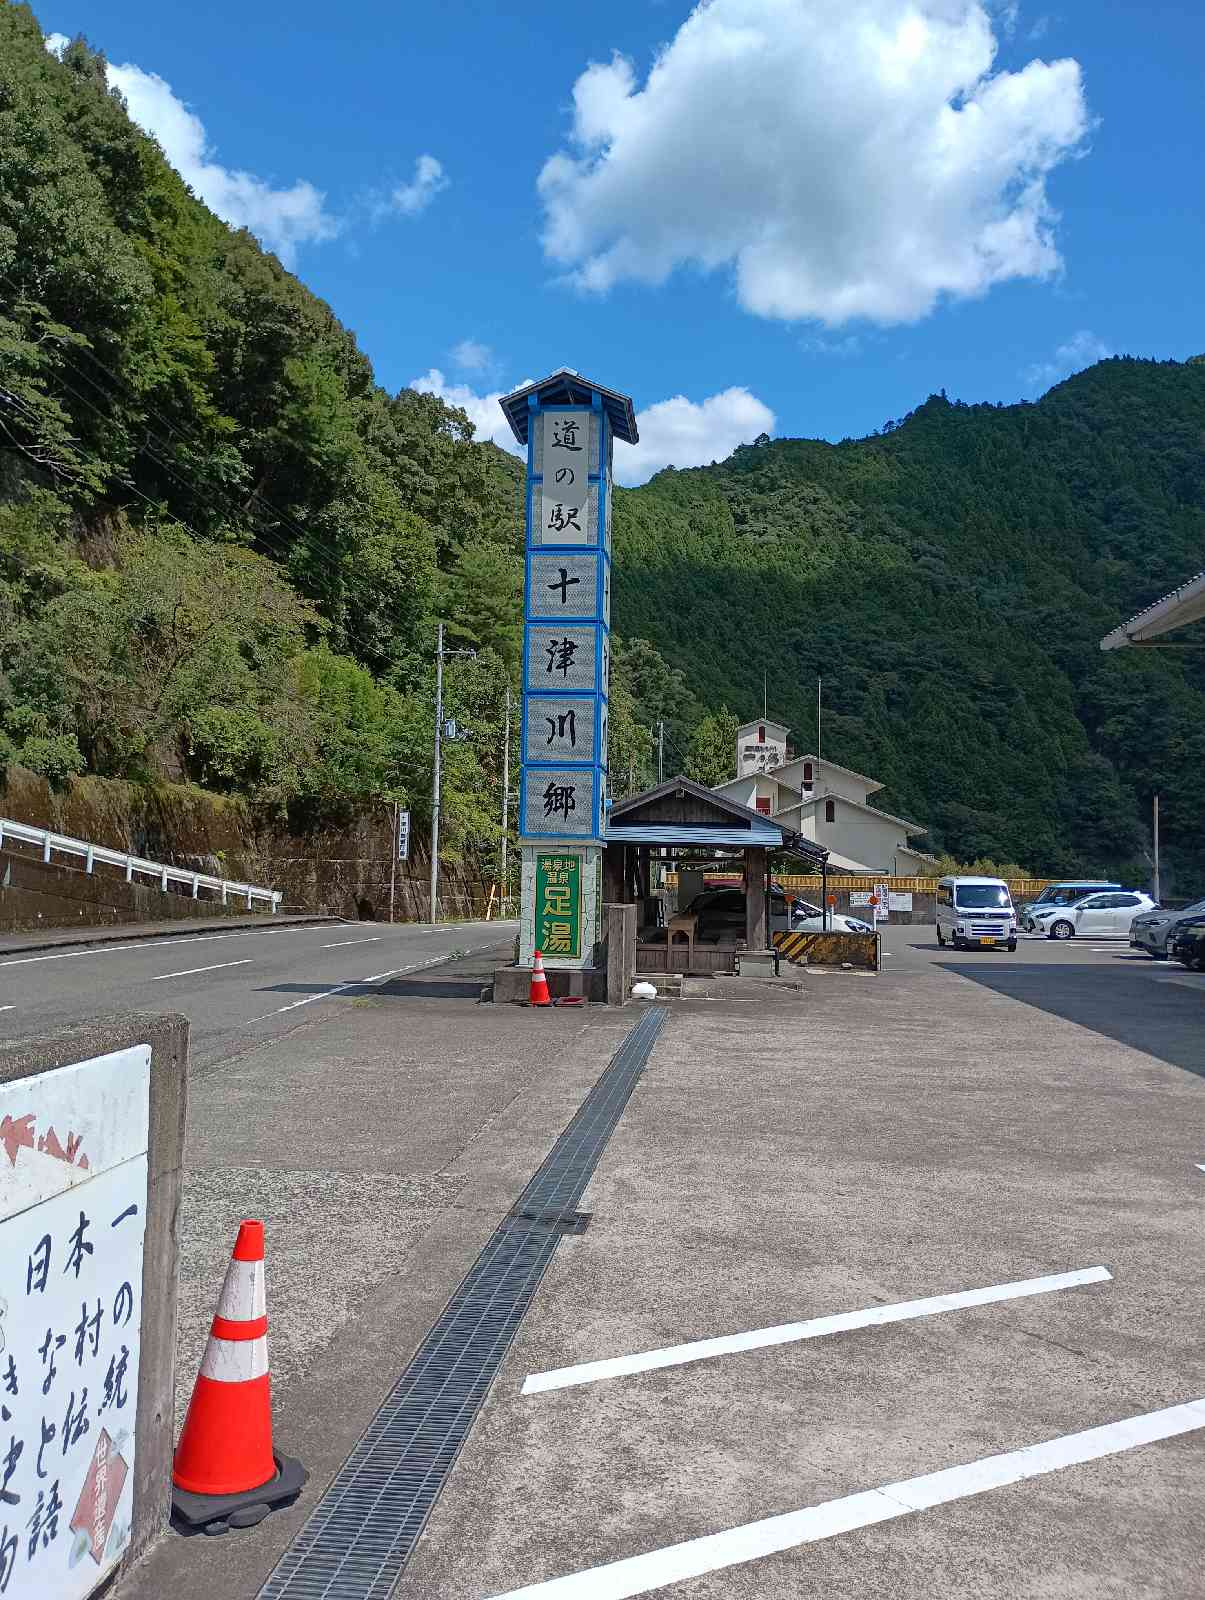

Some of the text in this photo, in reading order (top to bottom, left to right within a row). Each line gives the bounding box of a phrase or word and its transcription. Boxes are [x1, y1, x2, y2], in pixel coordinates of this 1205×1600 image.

[547, 420, 583, 532] 道の駅
[542, 568, 580, 823] 十津川郷
[542, 886, 572, 952] 足湯
[546, 871, 570, 885] 温泉
[26, 1203, 138, 1296] 日本一
[0, 1281, 134, 1422] きな村の
